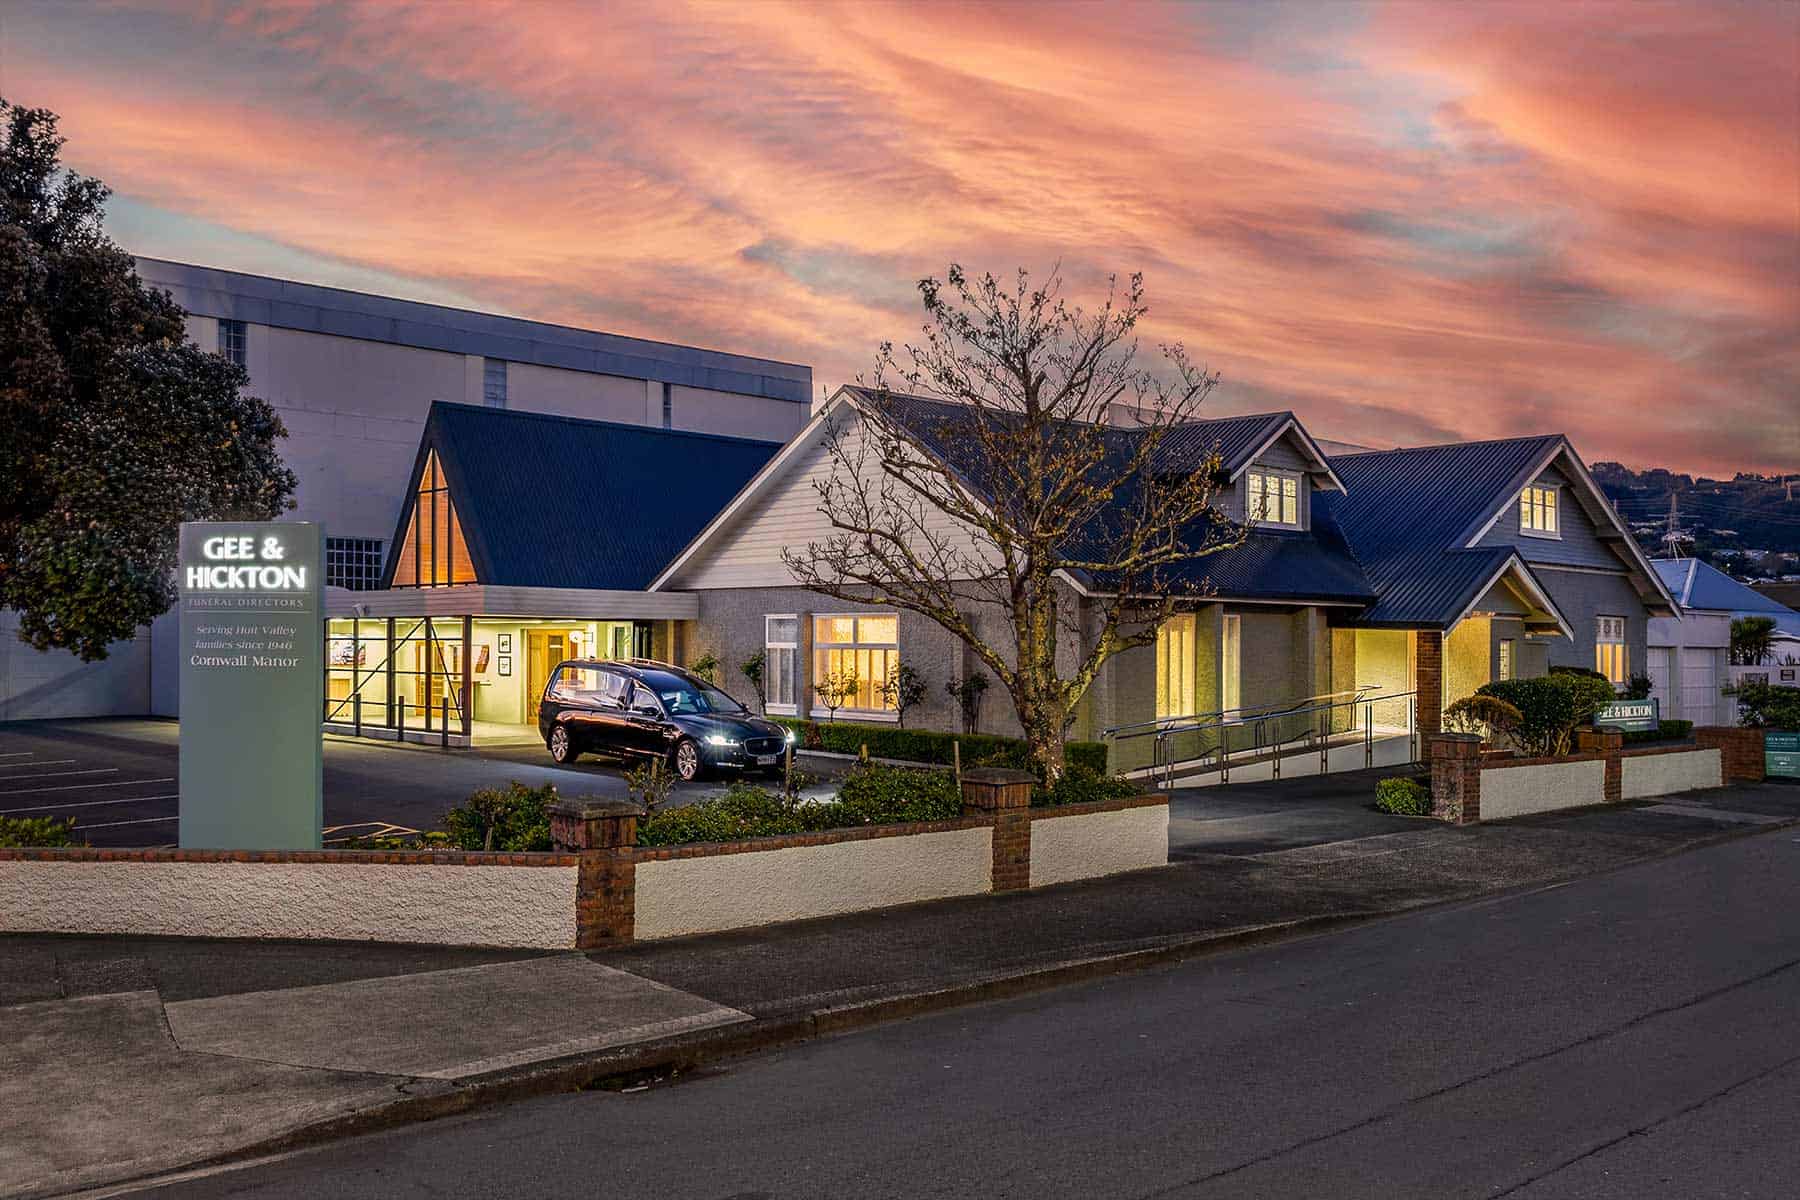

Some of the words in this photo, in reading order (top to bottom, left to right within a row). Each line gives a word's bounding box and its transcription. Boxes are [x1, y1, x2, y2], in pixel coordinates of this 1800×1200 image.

[203, 537, 256, 560] GEE
[260, 537, 285, 560] &
[186, 566, 306, 589] HICKTON
[189, 598, 233, 608] FUNERAL
[238, 598, 304, 608] DIRECTORS
[196, 624, 233, 636] Serving
[235, 624, 258, 635] Hutt
[262, 624, 297, 637] Valley
[194, 639, 233, 650] families
[236, 639, 265, 650] since
[190, 655, 247, 667] Cornwall
[252, 655, 298, 667] Manor
